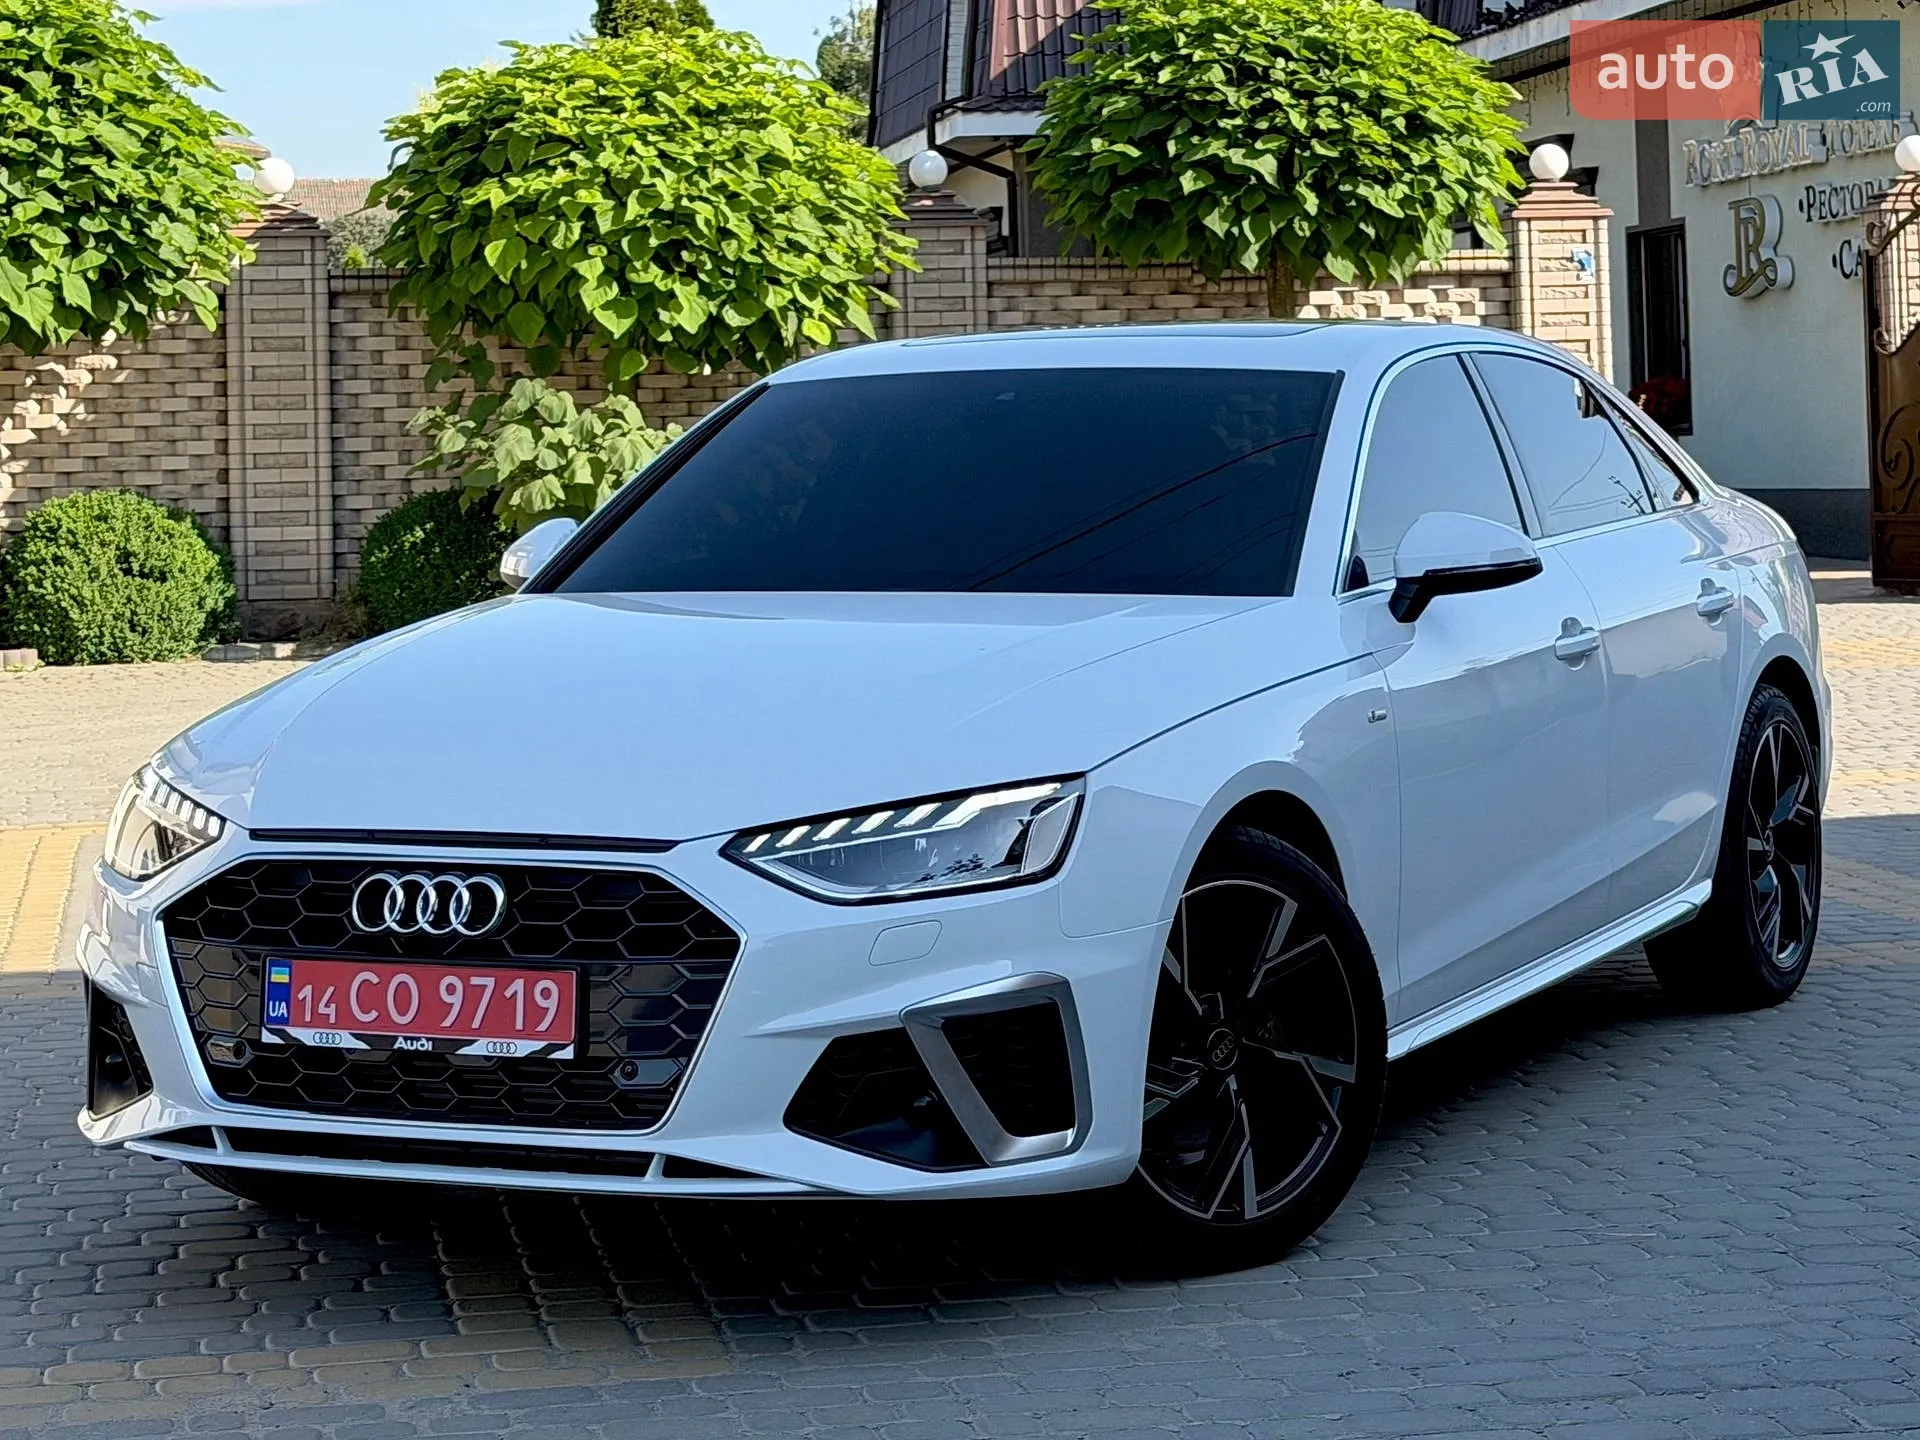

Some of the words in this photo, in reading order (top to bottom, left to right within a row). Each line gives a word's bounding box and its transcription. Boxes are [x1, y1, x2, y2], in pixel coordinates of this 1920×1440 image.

[1739, 122, 1814, 178] ROYAL
[268, 1000, 288, 1019] UA
[297, 984, 337, 1024] 14
[349, 971, 420, 1025] CO
[438, 975, 560, 1033] 9719
[393, 1035, 433, 1052] Audi
